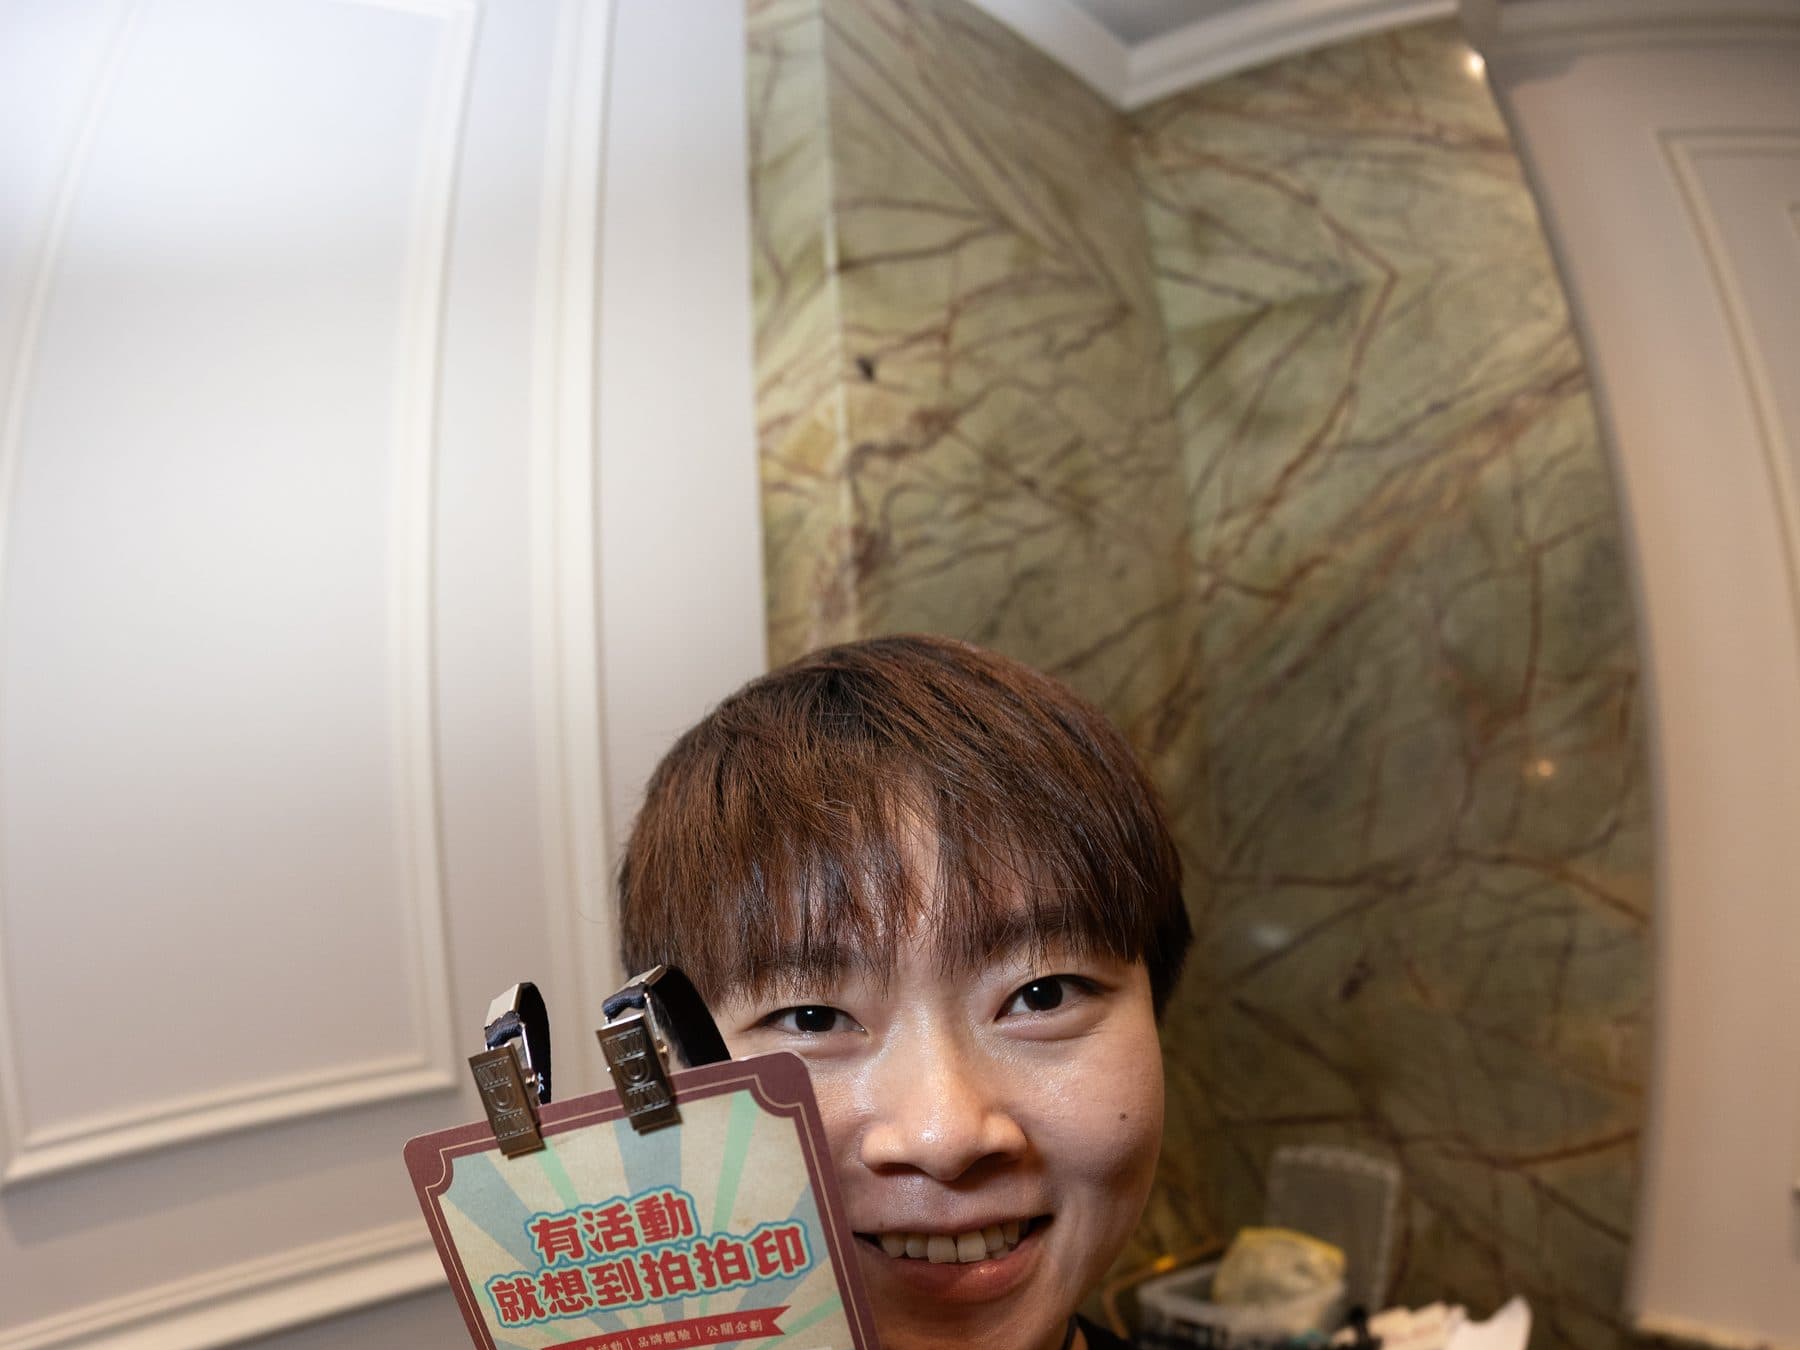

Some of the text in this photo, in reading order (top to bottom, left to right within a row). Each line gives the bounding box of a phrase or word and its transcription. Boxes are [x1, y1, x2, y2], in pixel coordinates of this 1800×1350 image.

[530, 1192, 695, 1266] 有活動
[491, 1226, 808, 1323] 就想到拍拍印
[637, 1328, 693, 1349] 品牌體驗
[705, 1318, 764, 1338] 公關企劃
